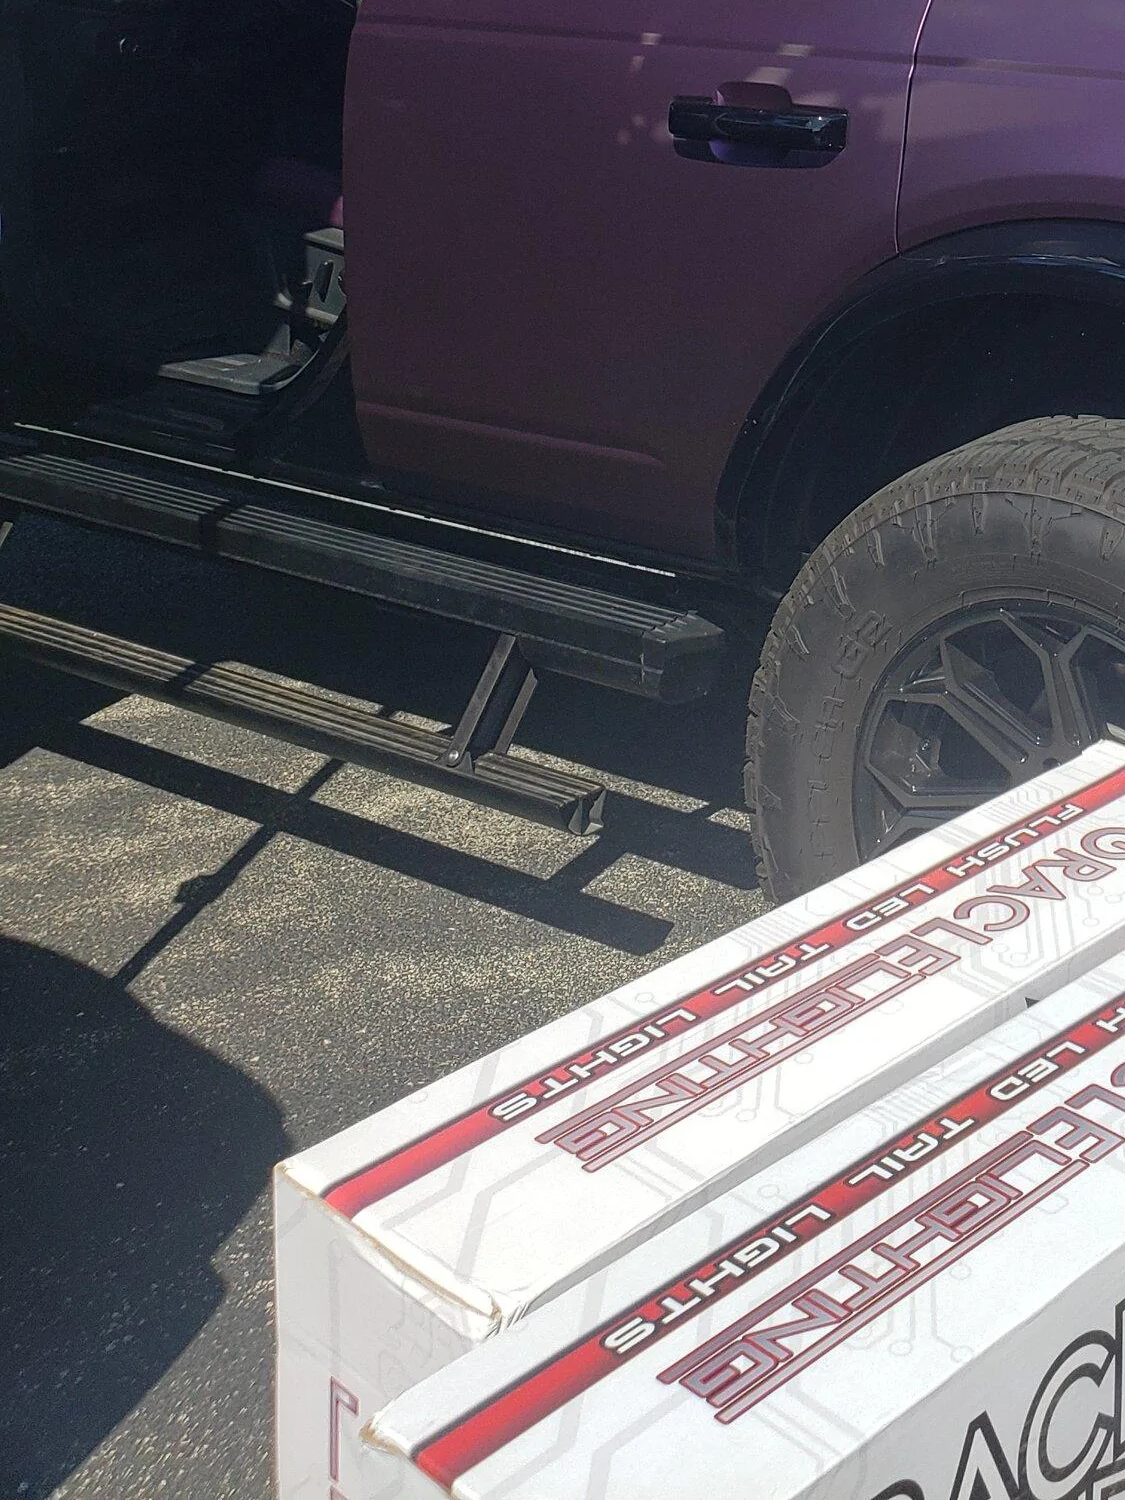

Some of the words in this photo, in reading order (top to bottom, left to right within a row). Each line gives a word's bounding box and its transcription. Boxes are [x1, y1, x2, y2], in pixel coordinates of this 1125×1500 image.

[945, 803, 1087, 878] FLUSH
[842, 882, 939, 932] LED
[712, 940, 832, 996] TAIL
[488, 1006, 700, 1124] LIGHTS
[987, 1040, 1087, 1102] LED
[847, 1116, 976, 1190] TAIL
[600, 1203, 836, 1356] LIGHTS
